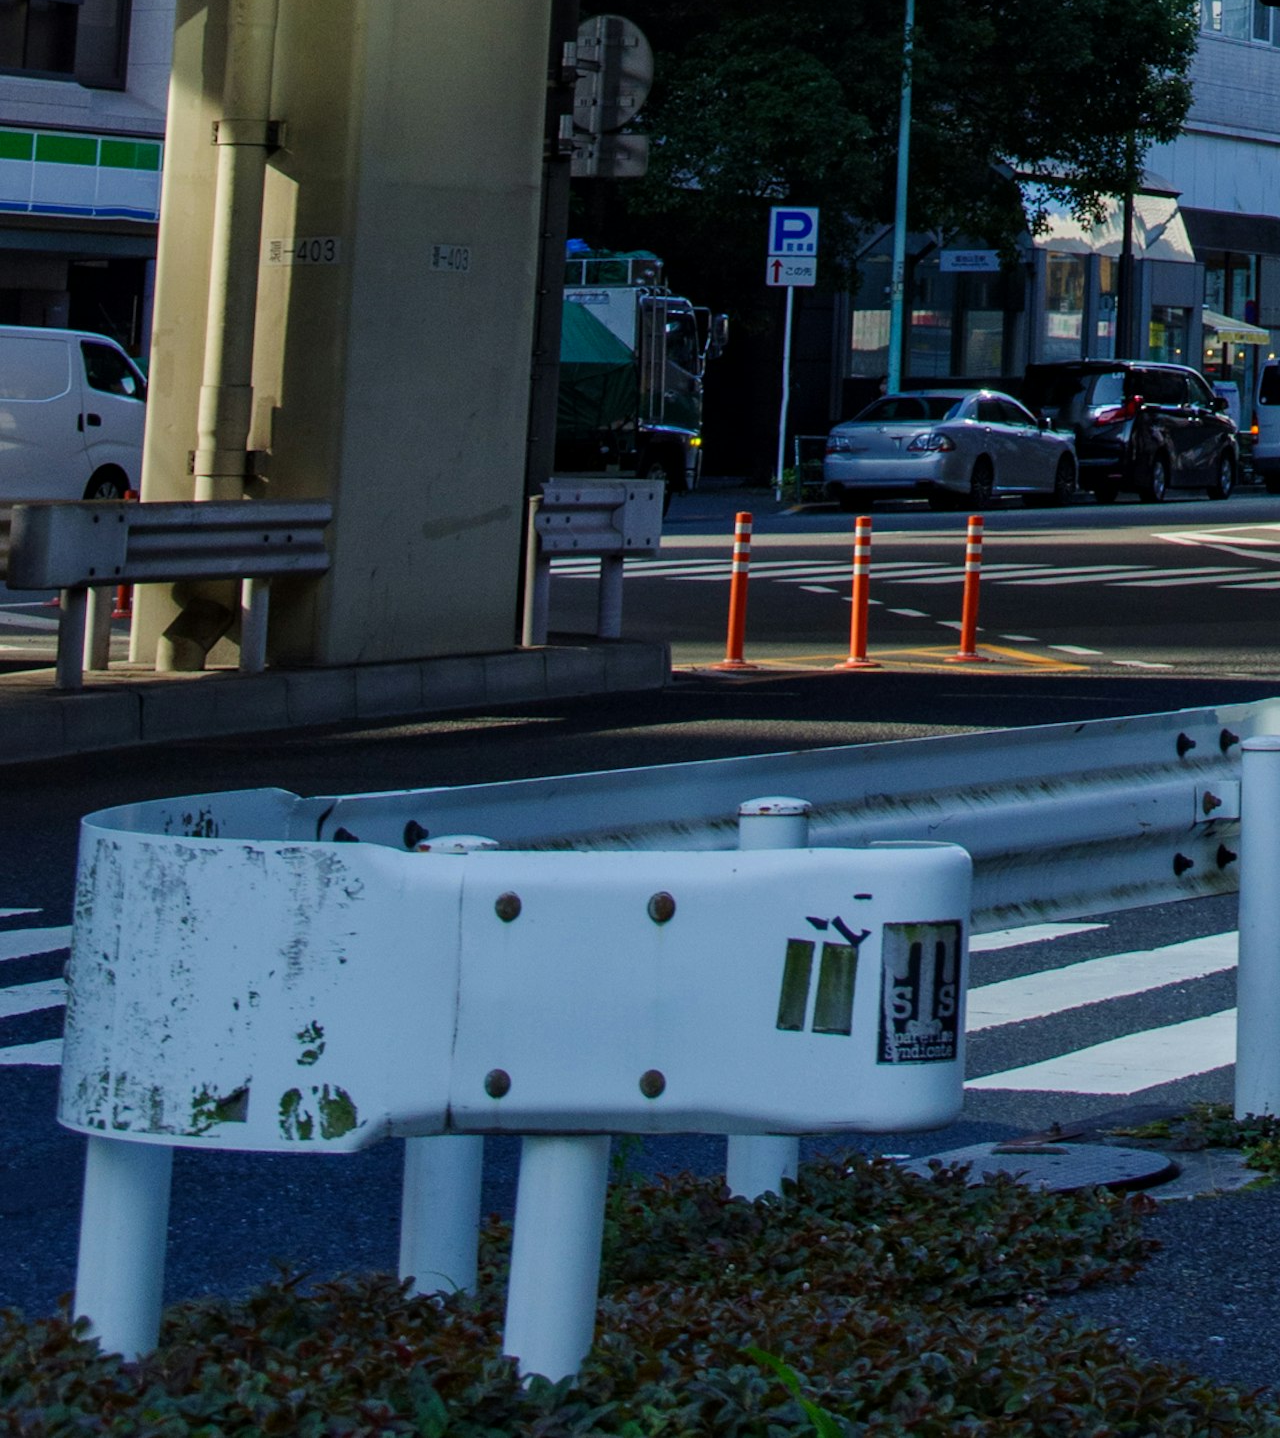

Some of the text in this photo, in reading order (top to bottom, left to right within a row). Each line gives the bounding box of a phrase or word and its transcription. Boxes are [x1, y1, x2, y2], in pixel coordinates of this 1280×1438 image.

[774, 211, 813, 252] P
[785, 267, 813, 277] この先
[885, 1044, 954, 1061] Syndicate
